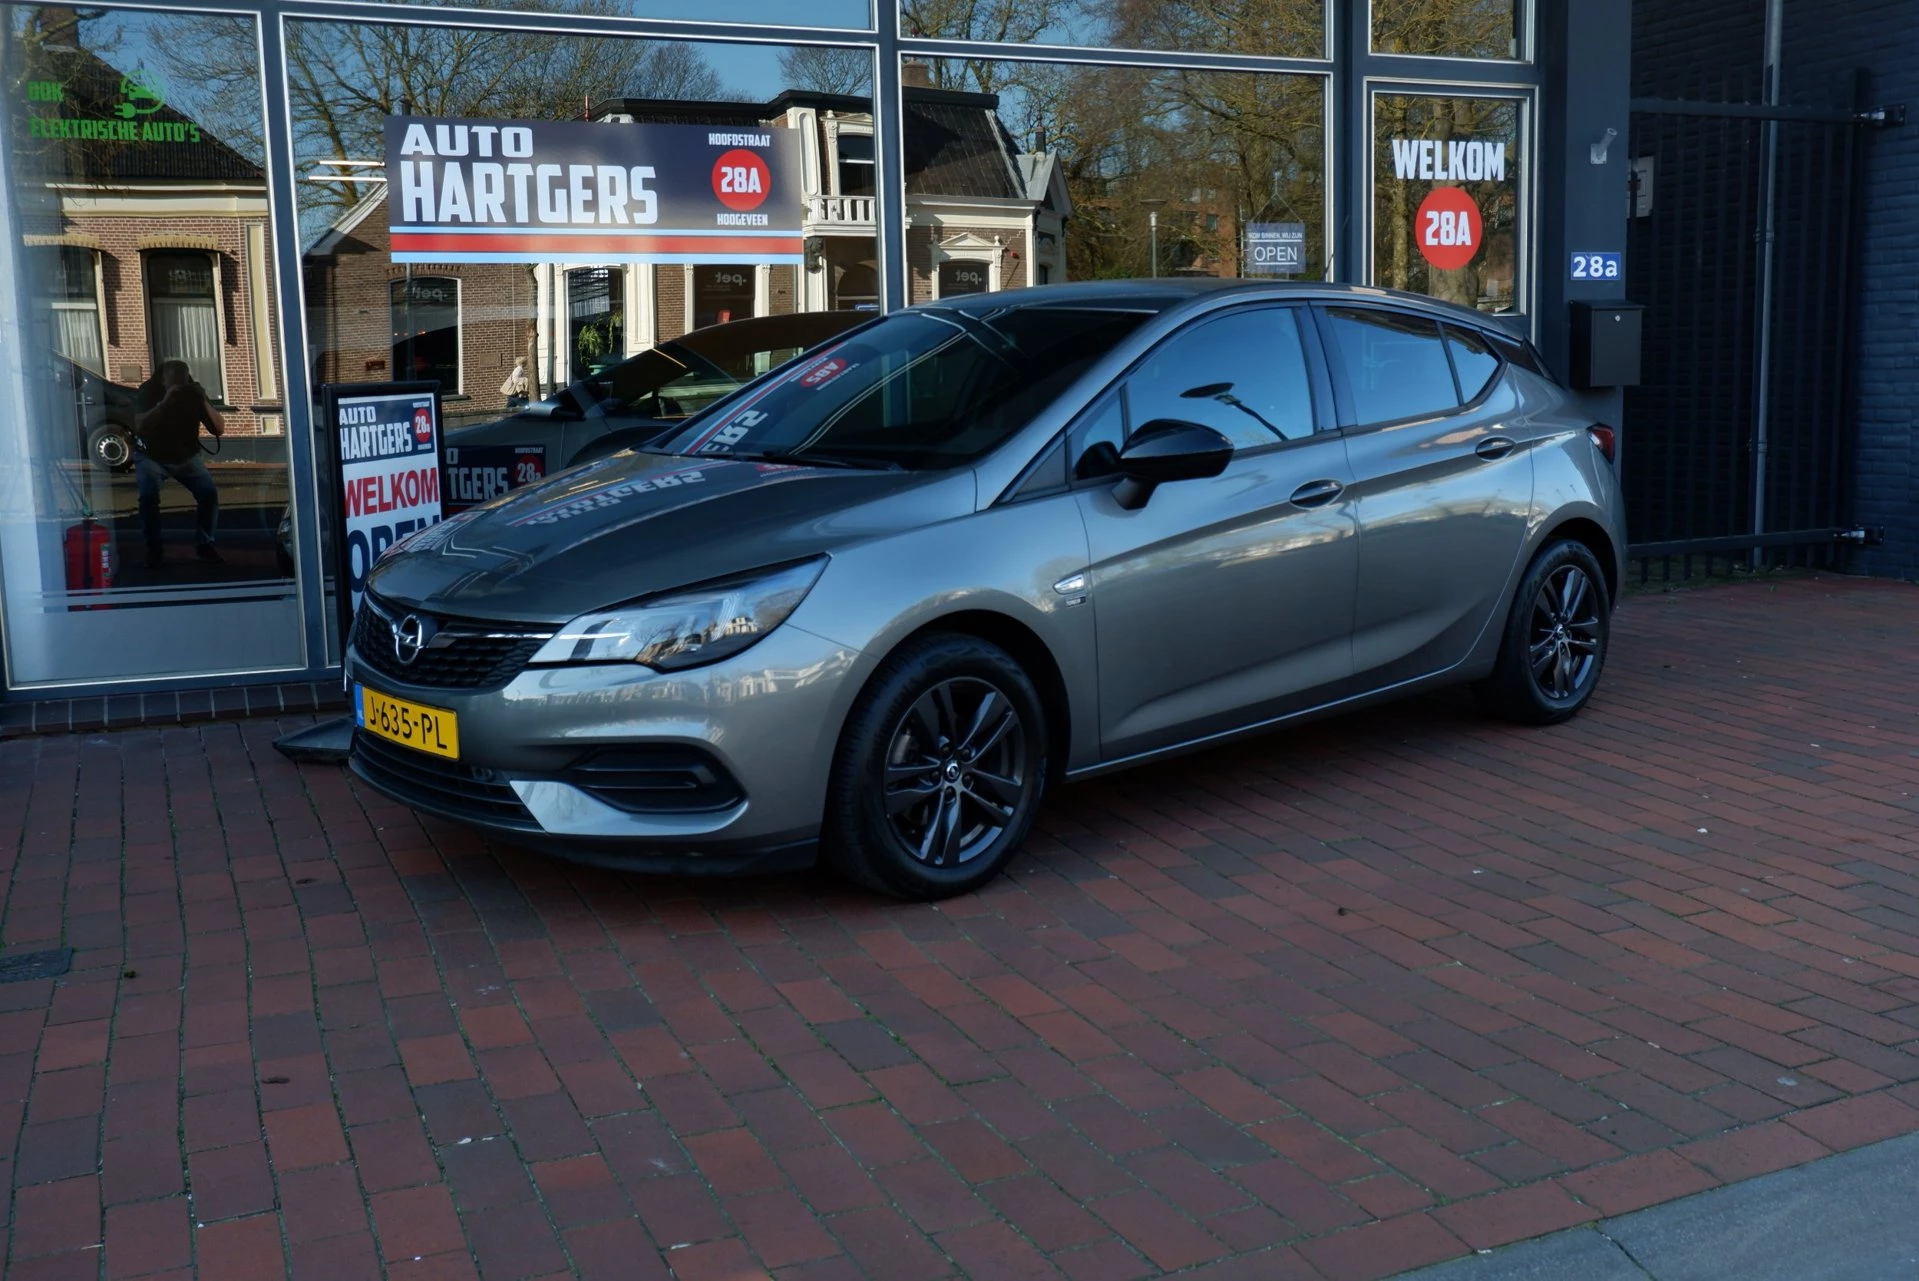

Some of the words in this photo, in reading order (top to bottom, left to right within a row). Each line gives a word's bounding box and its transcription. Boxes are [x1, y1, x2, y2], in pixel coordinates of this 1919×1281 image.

[29, 118, 138, 140] ELEKTRISCHE
[142, 122, 200, 142] AUTO'S
[400, 124, 534, 158] AUTO
[708, 133, 771, 147] HOOFDSTRAAT
[1392, 139, 1505, 181] WELKOM
[400, 161, 658, 225] HARTGERS
[721, 166, 762, 193] 28A
[717, 213, 768, 226] HOOGEVEEN
[1425, 211, 1472, 246] 28A
[1254, 246, 1298, 262] OPEN
[1573, 256, 1618, 278] 28a
[339, 405, 376, 425] AUTO
[340, 421, 413, 461] HARTGERS
[345, 467, 439, 518] WELKOM
[370, 696, 447, 750] J-635-PL
